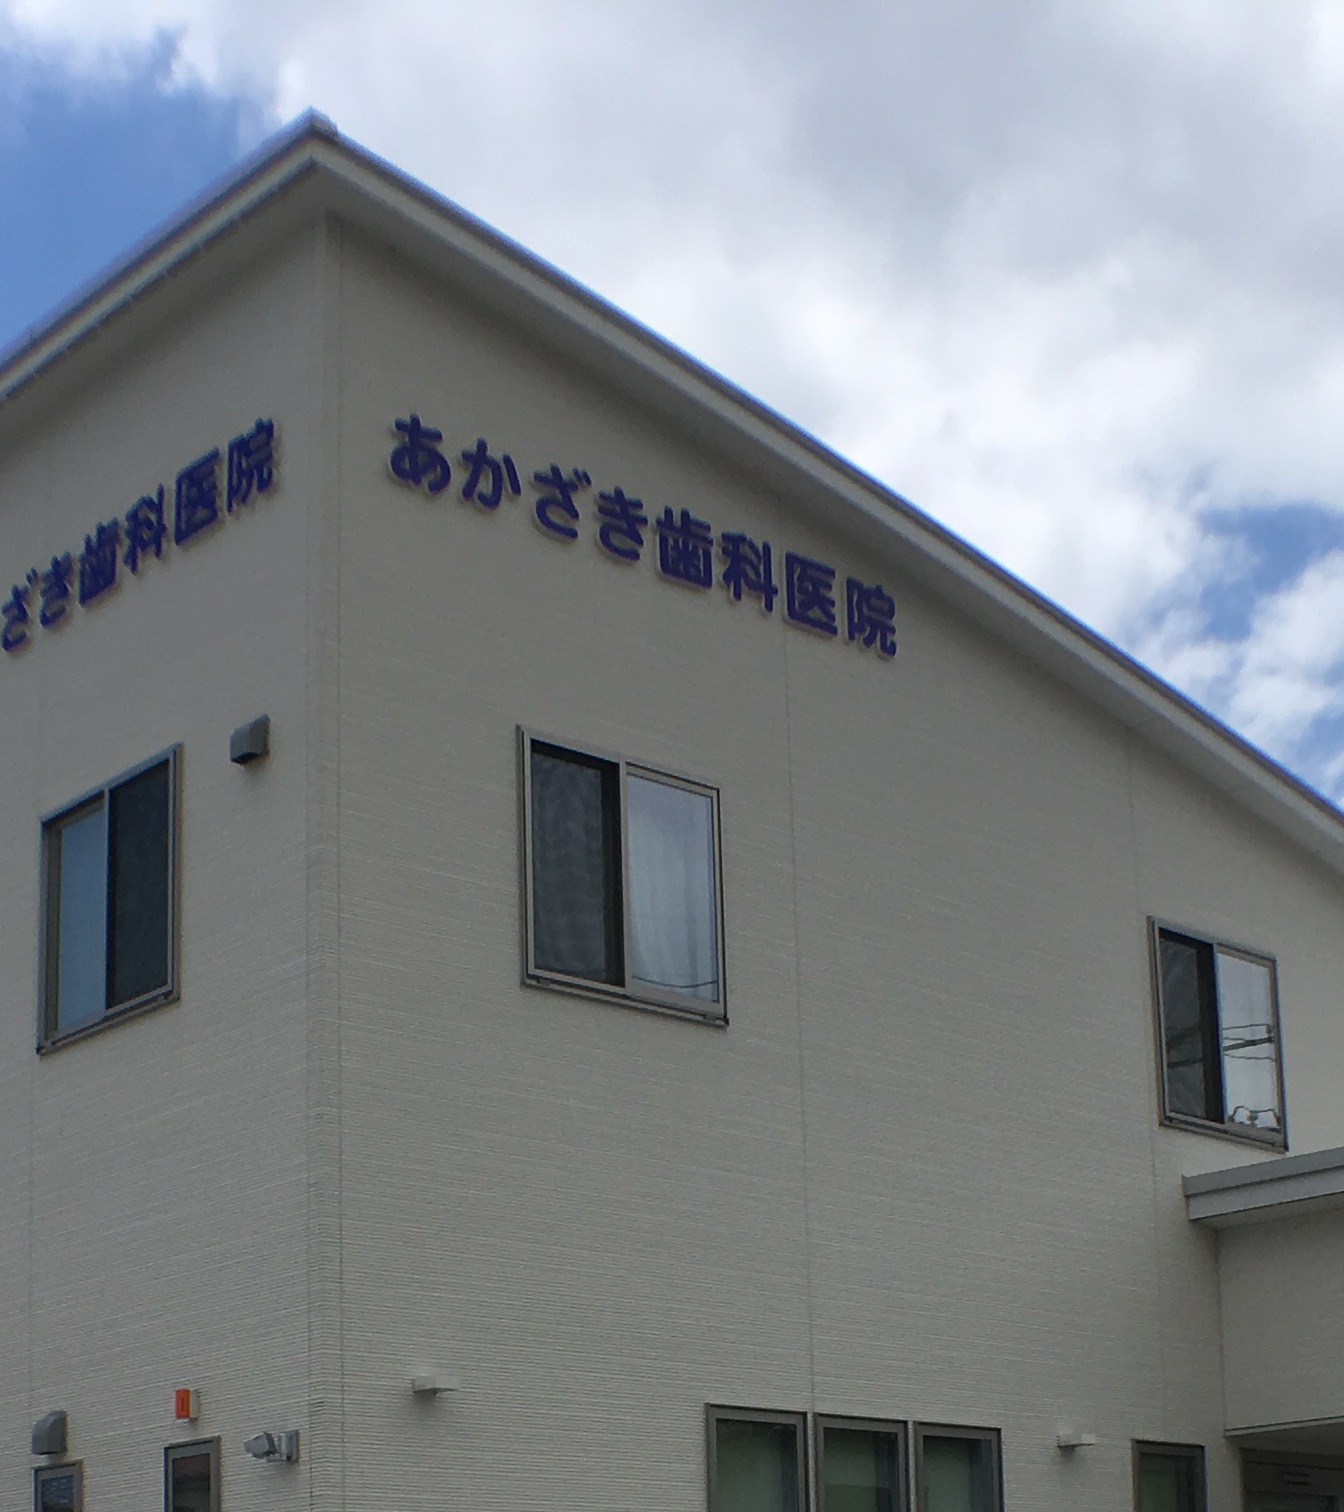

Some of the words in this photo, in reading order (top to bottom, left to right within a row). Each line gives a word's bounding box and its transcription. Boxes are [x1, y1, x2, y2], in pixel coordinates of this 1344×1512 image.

[388, 412, 899, 657] あかざき歯科医院
